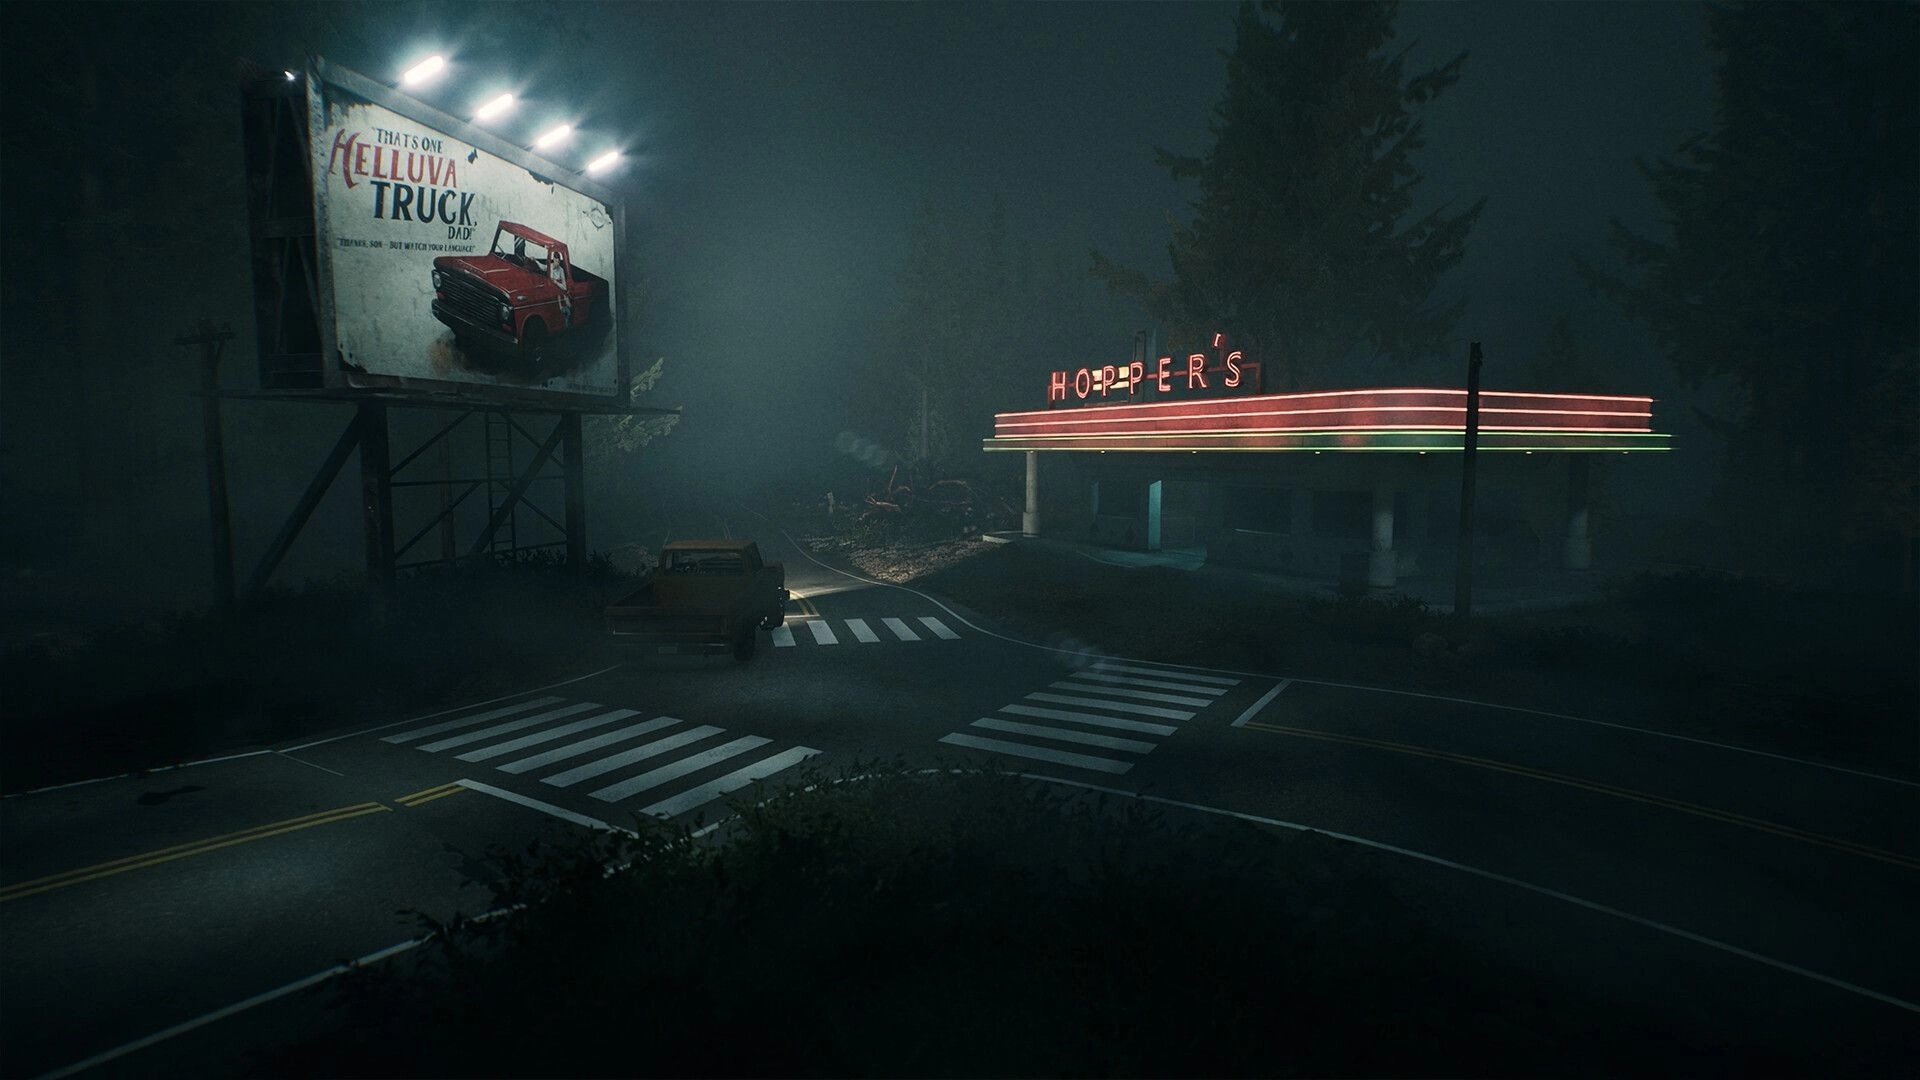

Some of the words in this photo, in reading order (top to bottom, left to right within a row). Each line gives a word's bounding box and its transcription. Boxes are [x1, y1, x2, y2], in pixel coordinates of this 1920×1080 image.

[328, 128, 457, 189] HELLUVA
[421, 136, 444, 153] ONE
[370, 180, 478, 227] TRUCK,
[389, 240, 402, 250] BUT
[404, 241, 427, 251] WATCH
[428, 242, 443, 251] YOUR
[1051, 332, 1243, 401] HOPPER'S
